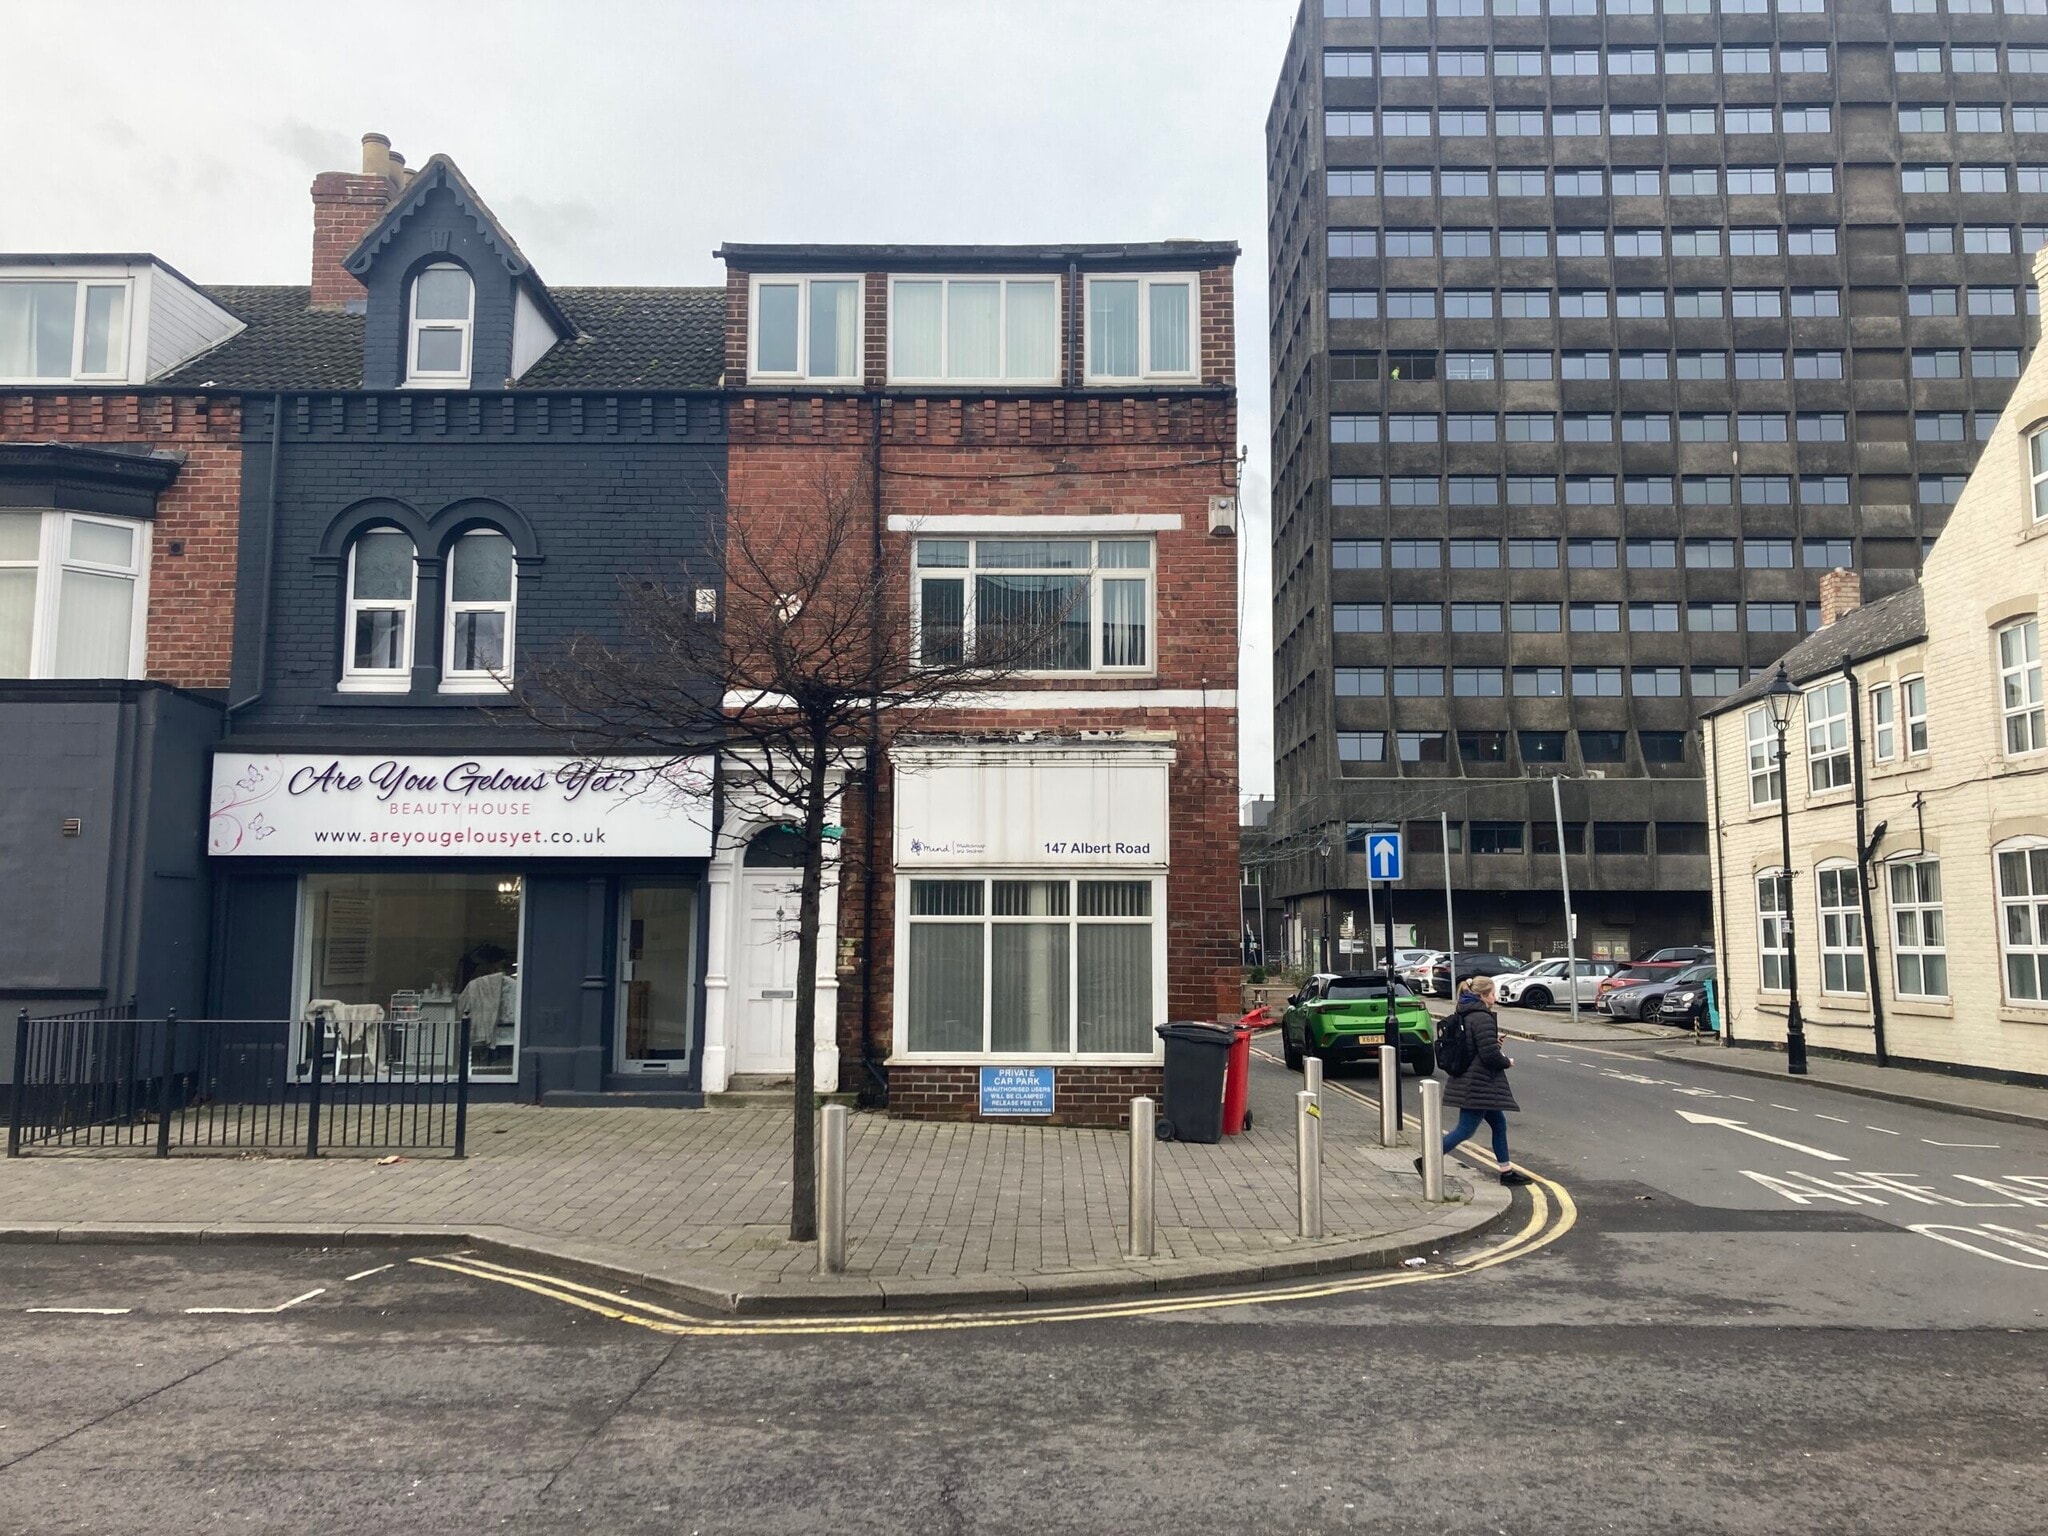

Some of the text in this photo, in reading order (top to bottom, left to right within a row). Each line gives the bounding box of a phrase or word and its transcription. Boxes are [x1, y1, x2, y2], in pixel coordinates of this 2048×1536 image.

[288, 761, 636, 801] Are You Gelous Yet?
[390, 803, 531, 815] BEAUTY HOUSE
[314, 827, 606, 847] www.areyougelousyet.co.uk
[1044, 842, 1151, 854] 147 Albert Road
[998, 1069, 1036, 1077] PRIVATE
[993, 1077, 1041, 1086] CAR PARK
